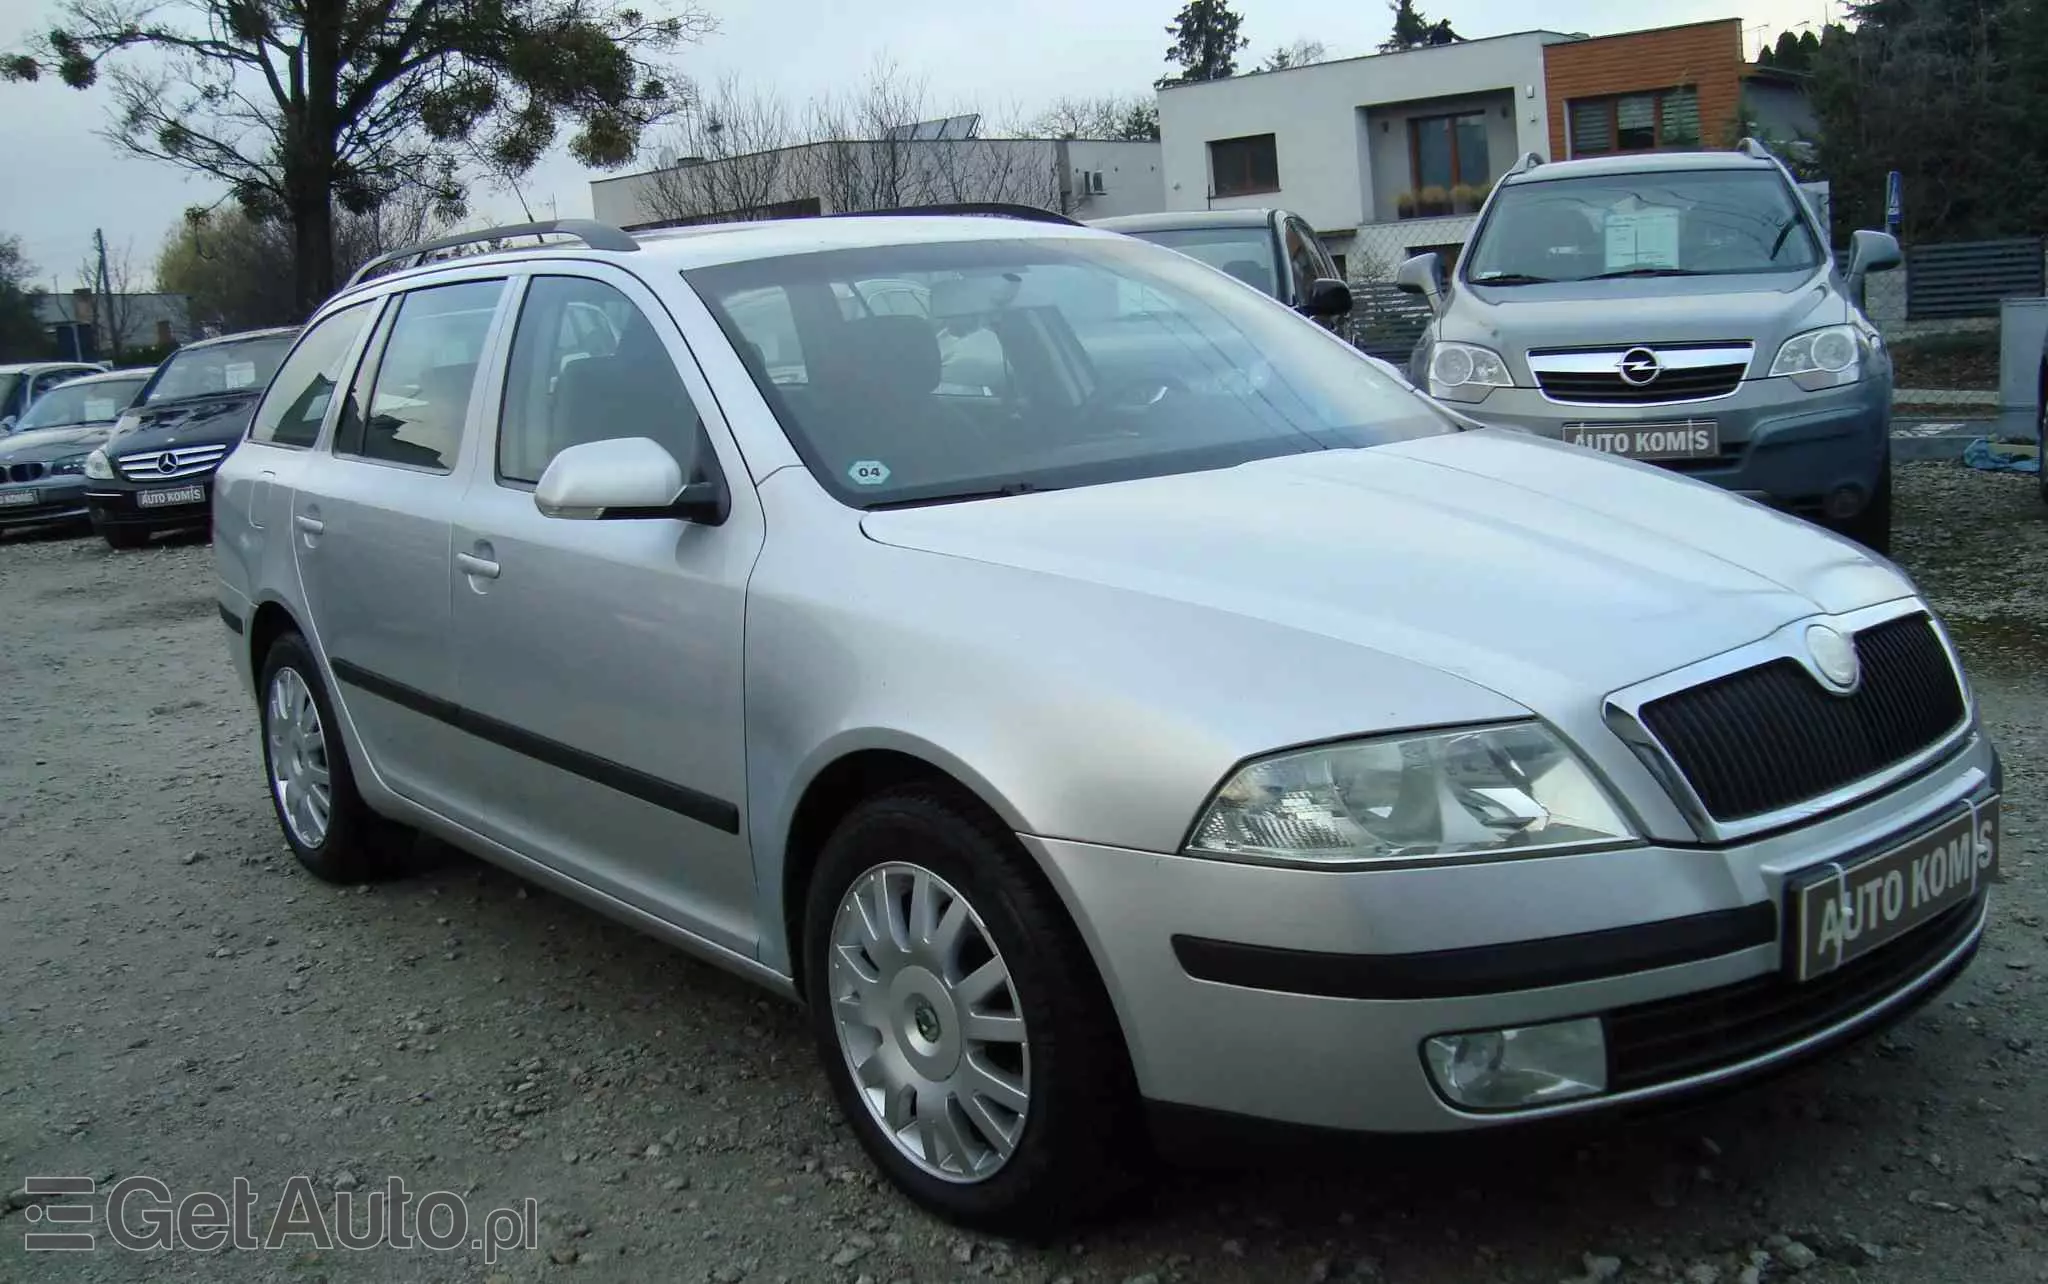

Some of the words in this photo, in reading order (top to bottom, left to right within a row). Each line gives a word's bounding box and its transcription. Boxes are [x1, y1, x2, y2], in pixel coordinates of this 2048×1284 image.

[1575, 433, 1629, 453] AUTO
[858, 467, 881, 477] 04
[142, 493, 165, 504] AUTO
[1818, 869, 1904, 955] AUTO
